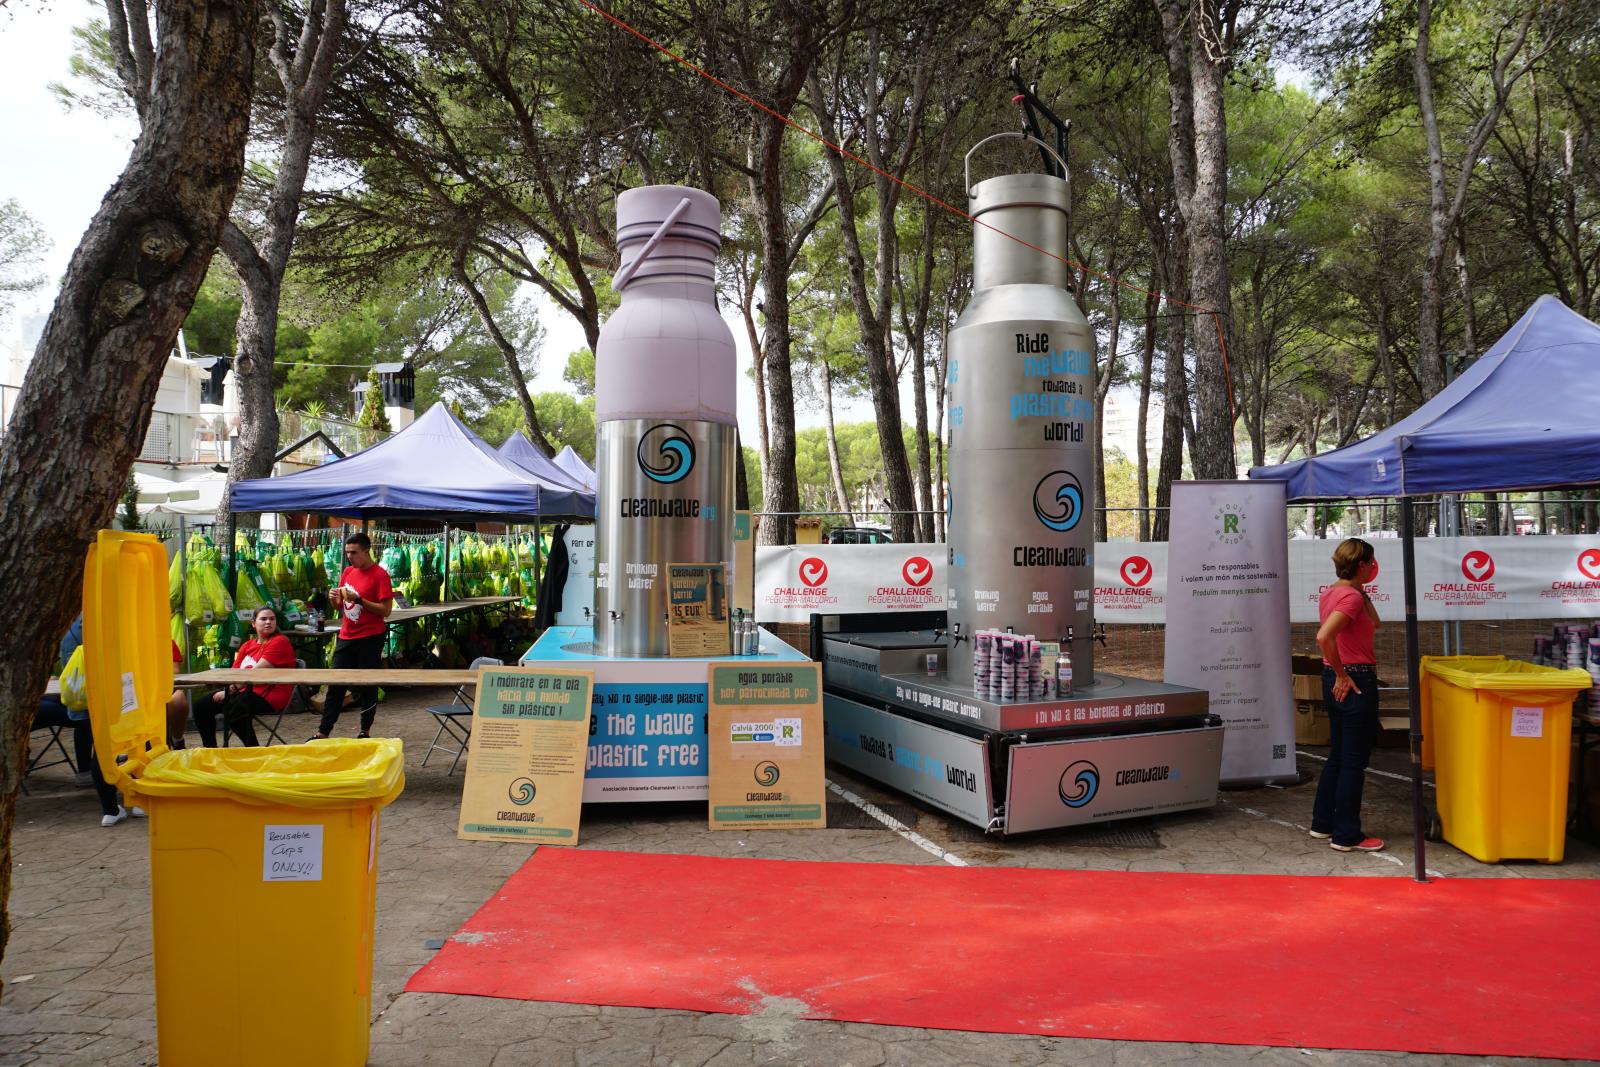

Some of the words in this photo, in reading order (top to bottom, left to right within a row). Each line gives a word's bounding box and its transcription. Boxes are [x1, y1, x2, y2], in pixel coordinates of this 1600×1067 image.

[774, 587, 828, 596] CHALLENGE
[876, 587, 933, 596] CHALLENGE
[1094, 587, 1153, 596] CHALLENGE
[1433, 583, 1495, 592] CHALLENGE
[1424, 592, 1507, 601] PEGUERA-MALLORCA
[634, 693, 674, 706] single-use
[677, 693, 704, 705] plastic
[607, 713, 636, 736] the
[644, 713, 694, 736] wave
[754, 723, 774, 732] 2000
[586, 744, 649, 770] plastic
[657, 744, 699, 767] free
[269, 831, 312, 841] Reusable
[271, 843, 304, 858] Cups
